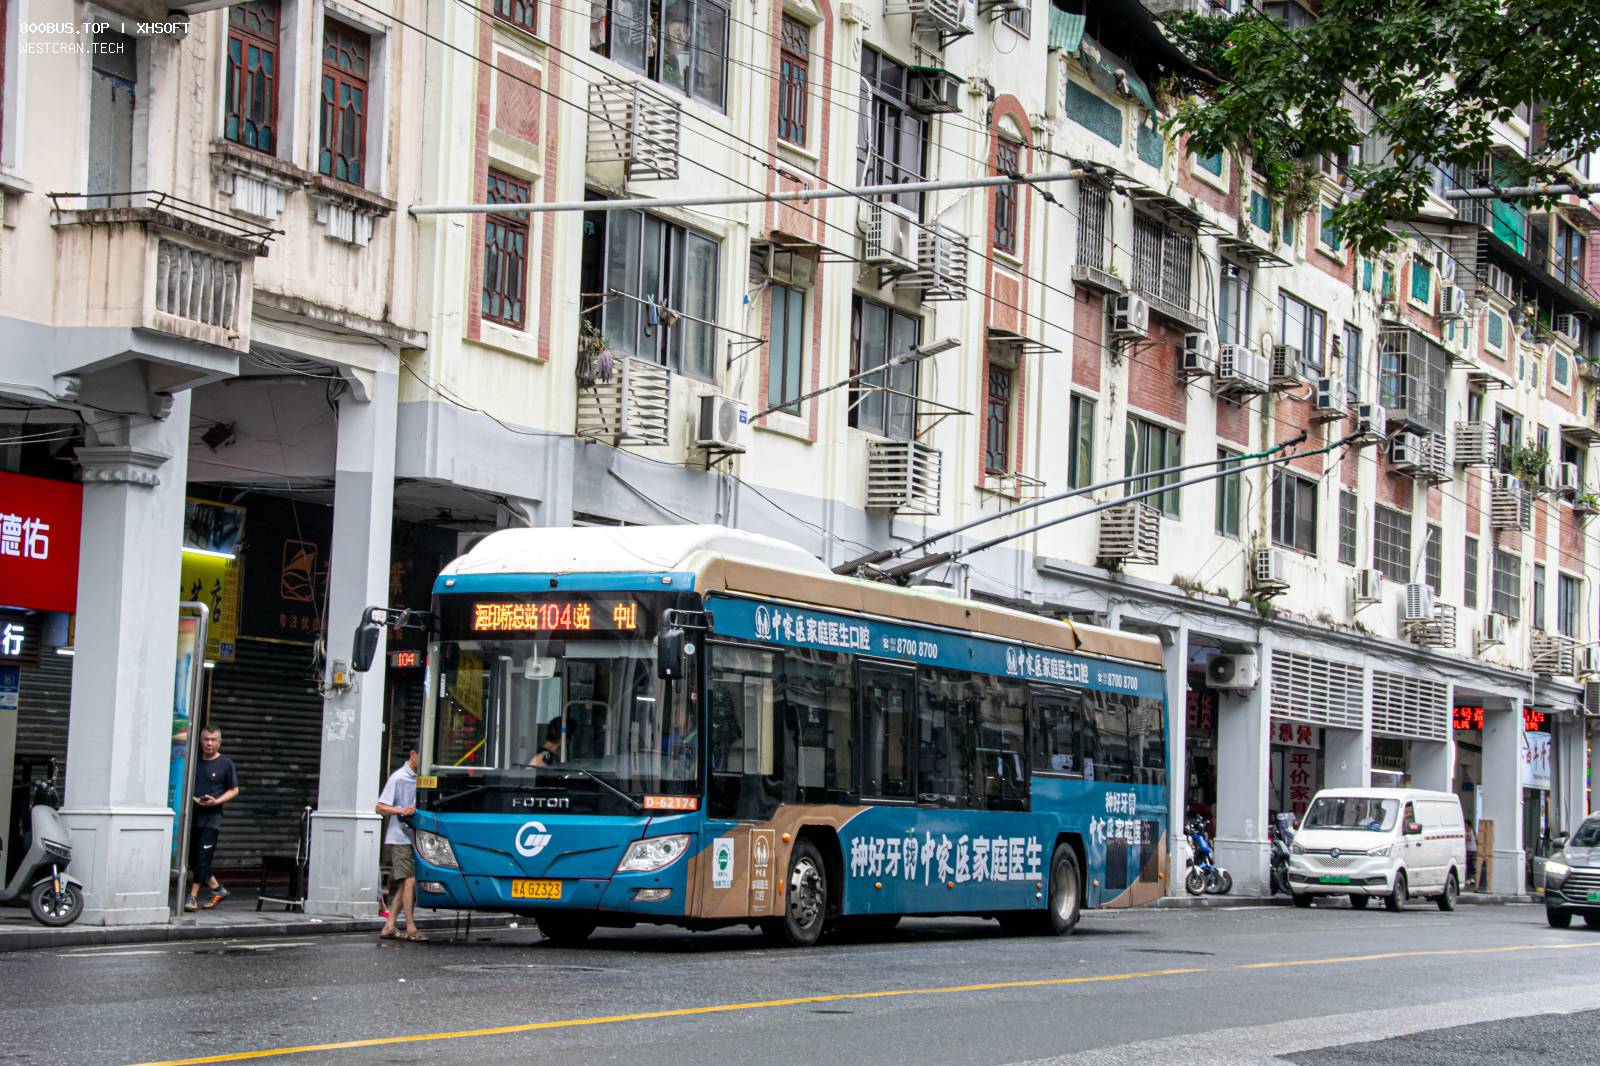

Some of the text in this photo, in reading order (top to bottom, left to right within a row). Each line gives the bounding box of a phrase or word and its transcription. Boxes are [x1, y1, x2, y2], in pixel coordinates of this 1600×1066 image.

[0, 512, 50, 560] 德佑
[2, 623, 25, 655] 行
[897, 637, 917, 656] 8700
[918, 641, 938, 659] 8700
[398, 652, 415, 668] 104
[1107, 673, 1122, 688] 8700
[1123, 675, 1138, 690] 8700
[645, 796, 697, 810] D-62174
